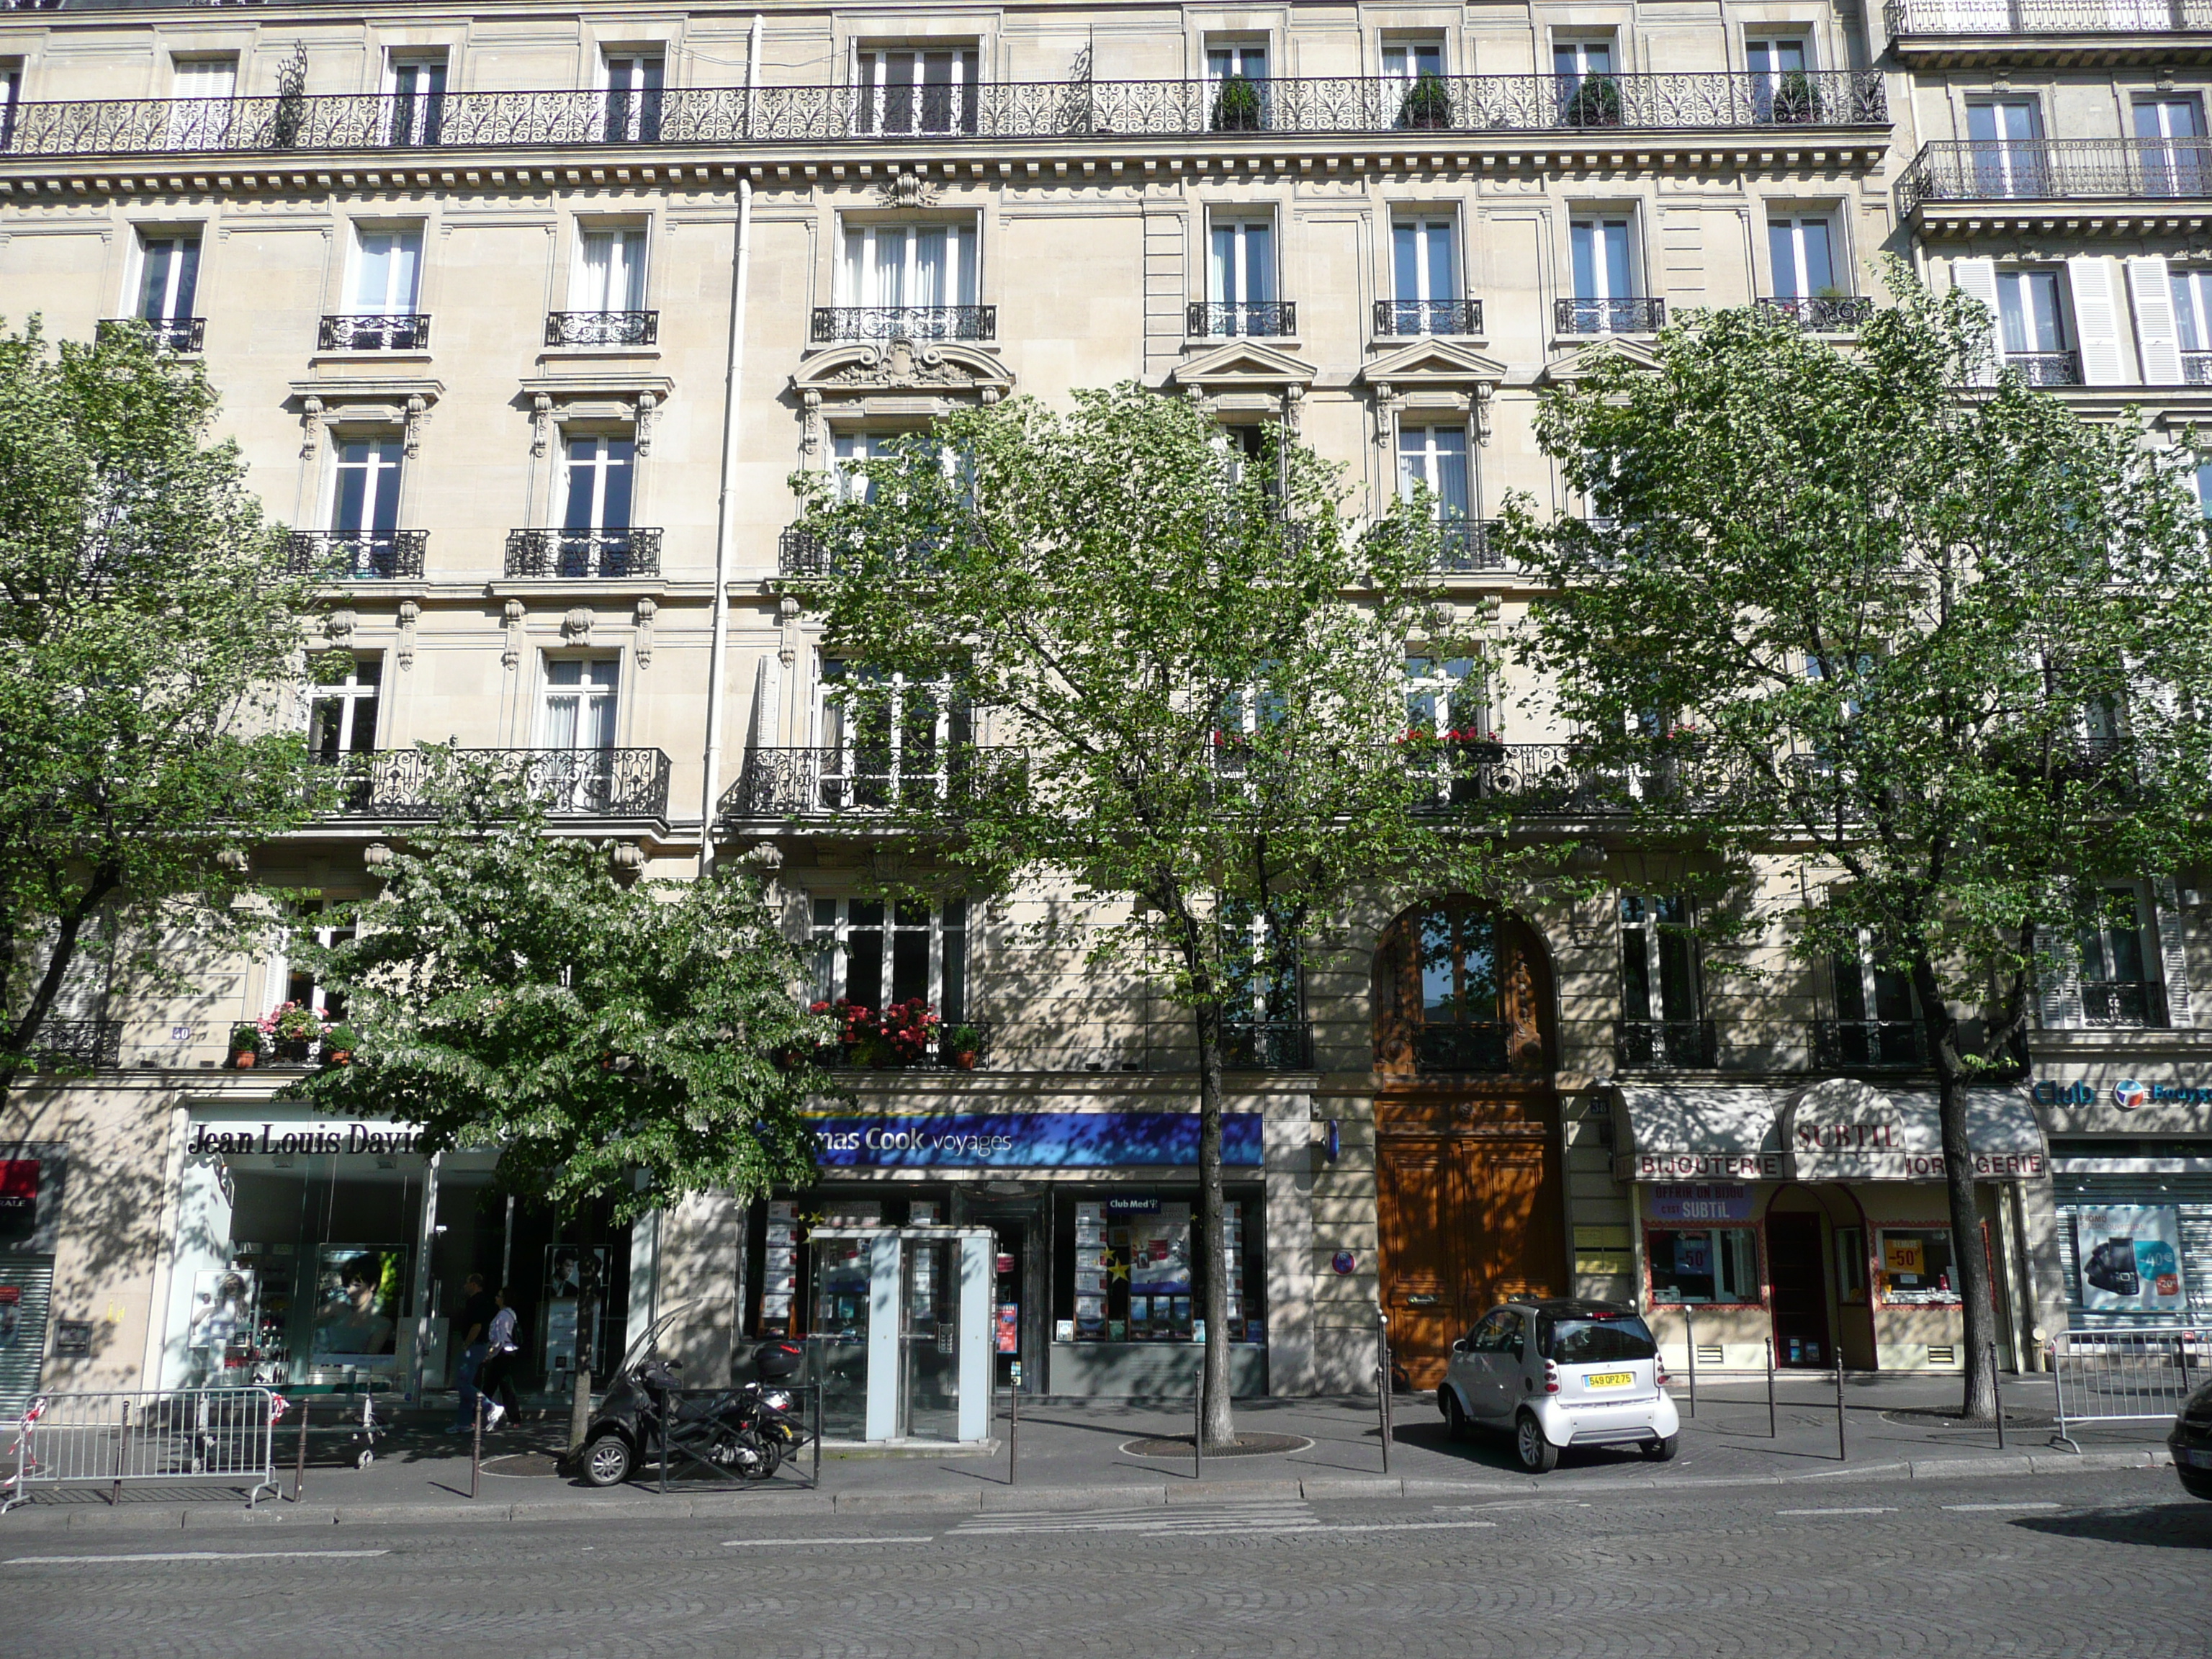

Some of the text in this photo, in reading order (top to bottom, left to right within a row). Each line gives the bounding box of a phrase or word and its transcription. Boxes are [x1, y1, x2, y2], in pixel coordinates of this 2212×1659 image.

[173, 1028, 189, 1040] 40
[2033, 1079, 2096, 1105] Club
[1591, 1101, 1607, 1113] 38
[187, 1123, 255, 1154] Jean
[258, 1123, 341, 1154] Louis
[866, 1127, 925, 1151] Cook
[932, 1135, 1012, 1157] voyages
[1798, 1123, 1899, 1148] SUBTIL
[1641, 1156, 1778, 1174] BIJOUTERIE
[1907, 1155, 2043, 1175] HORGERIE
[1655, 1187, 1744, 1199] OFFRIR UN BIJOU
[1110, 1199, 1149, 1208] Club Med
[2080, 1214, 2108, 1223] PROMO
[1588, 1376, 1604, 1385] 549
[1621, 1374, 1632, 1383] 75
